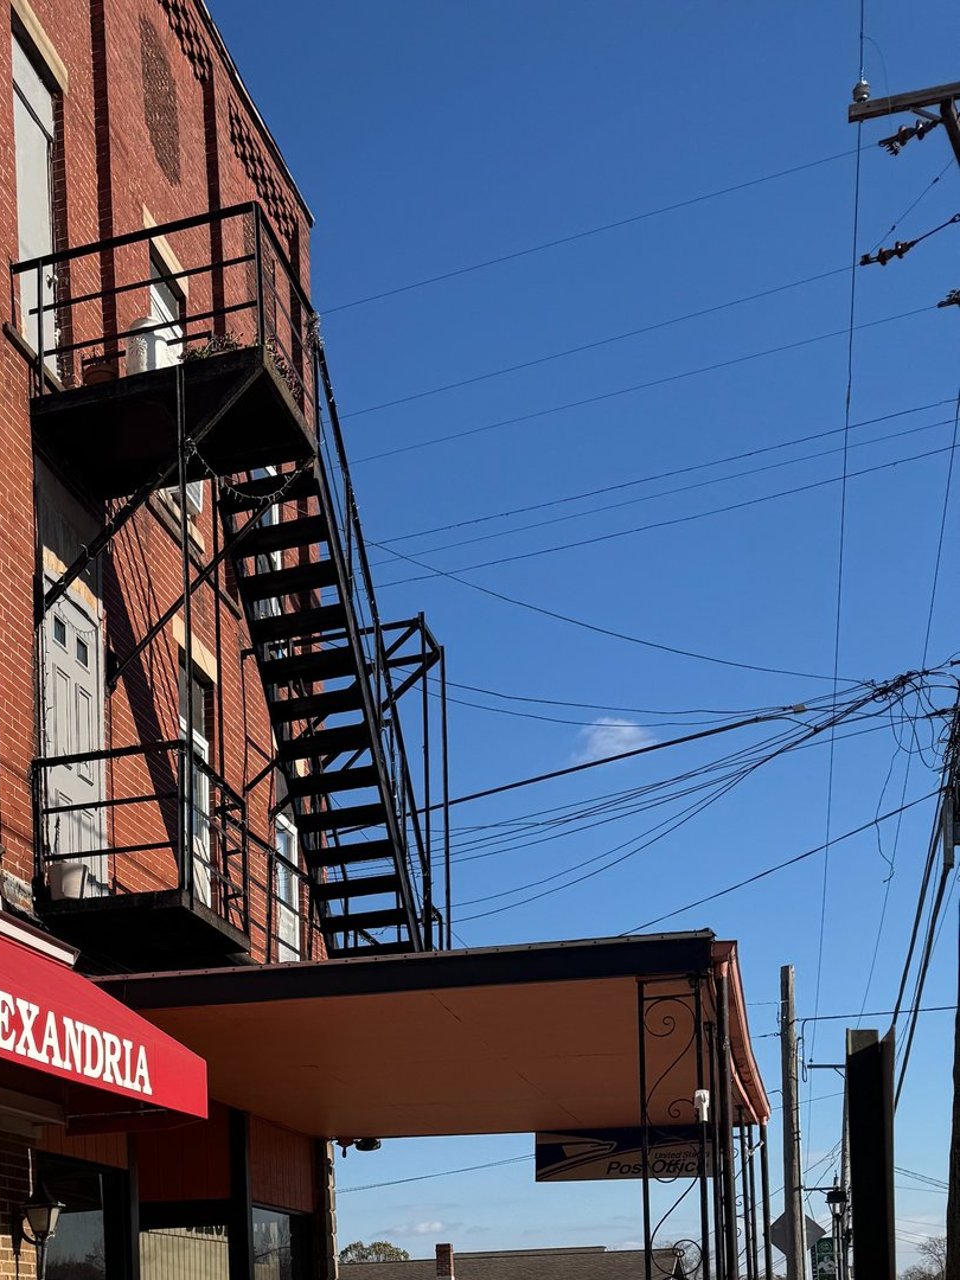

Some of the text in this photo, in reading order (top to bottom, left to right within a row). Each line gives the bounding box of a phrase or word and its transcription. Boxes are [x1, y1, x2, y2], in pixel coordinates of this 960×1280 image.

[655, 1151, 682, 1160] United
[606, 1158, 704, 1175] Pos Offic
